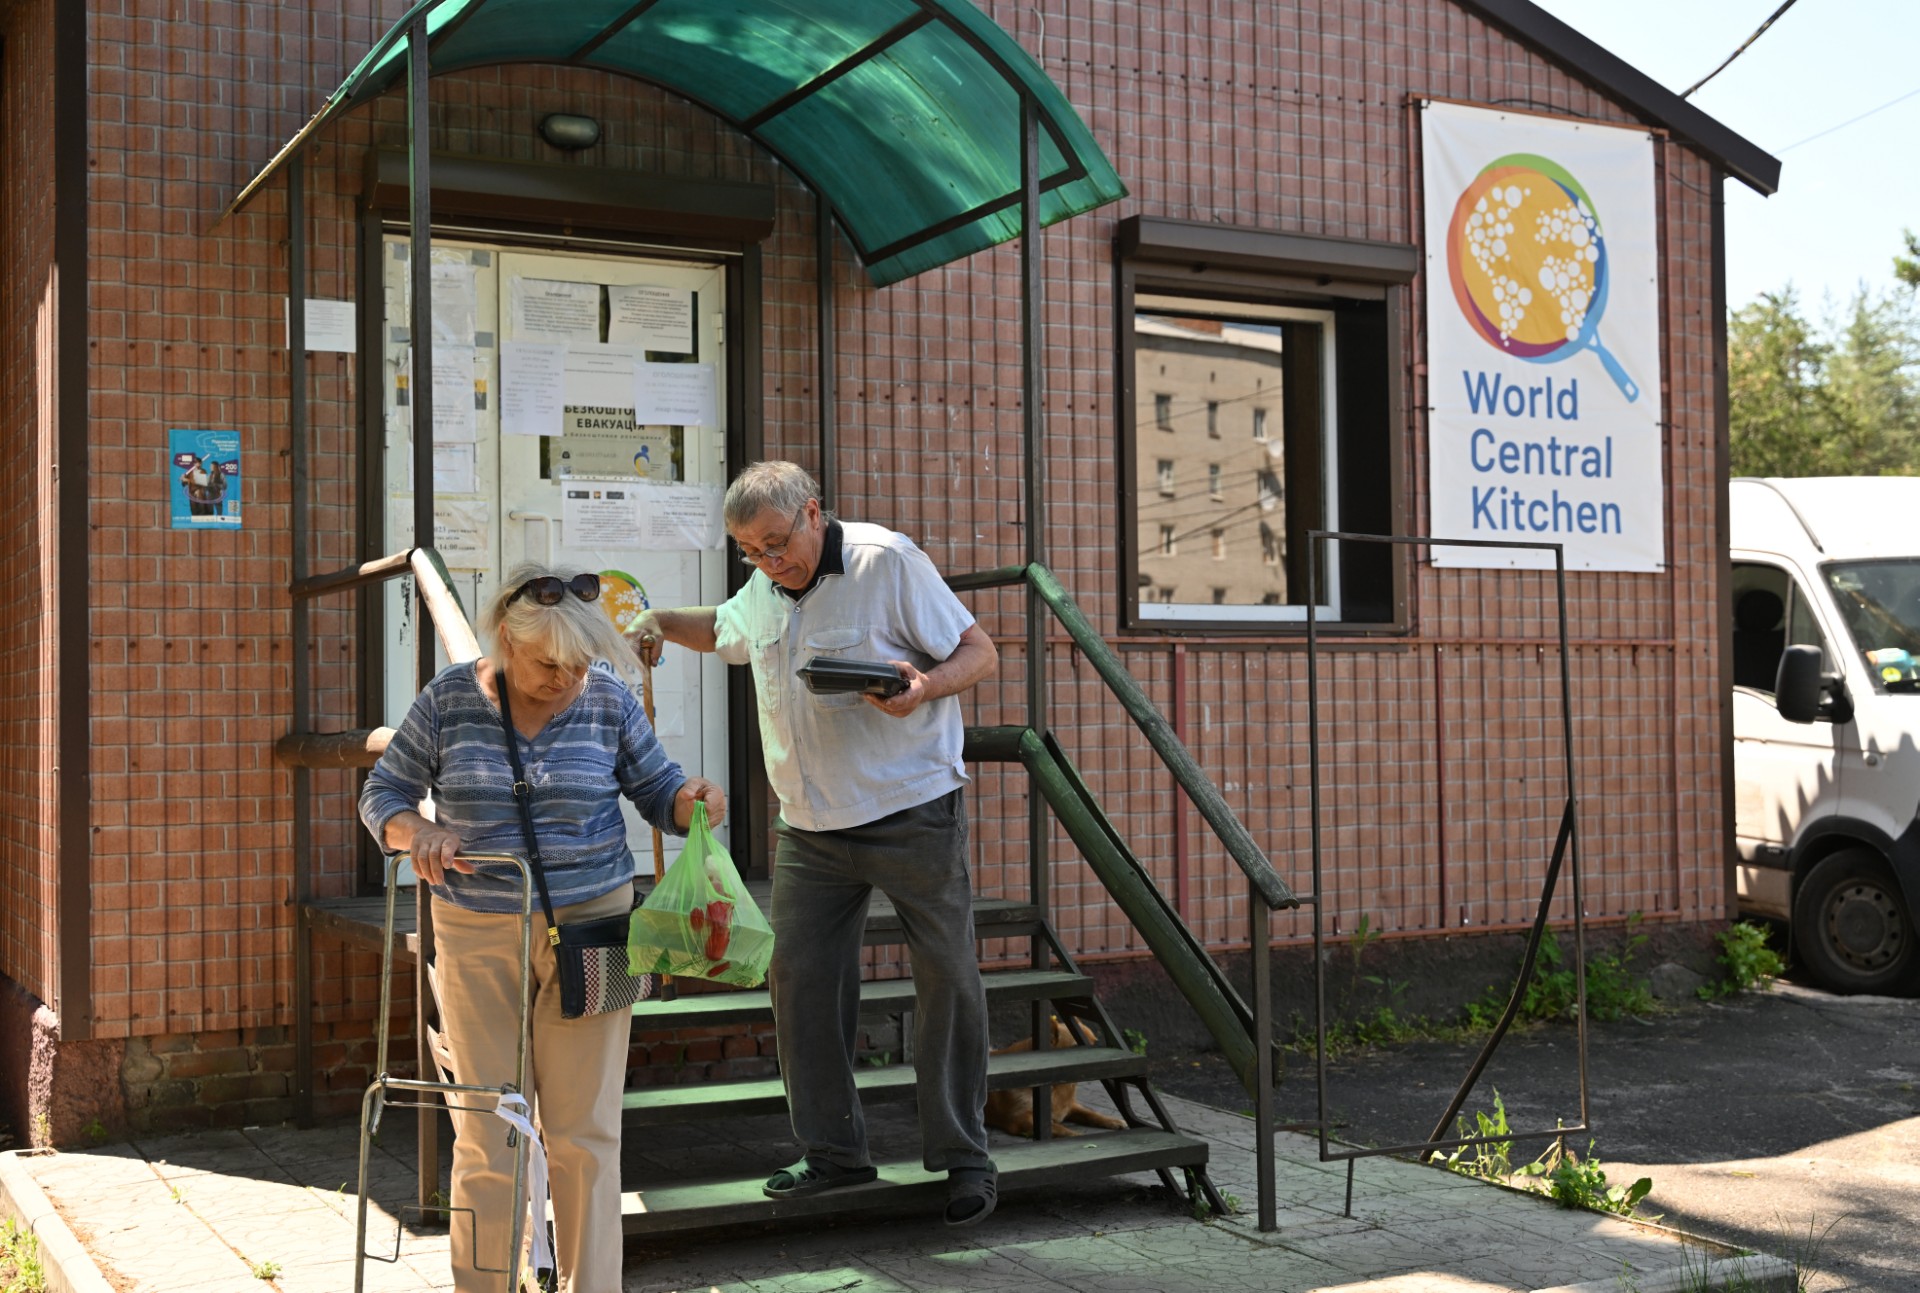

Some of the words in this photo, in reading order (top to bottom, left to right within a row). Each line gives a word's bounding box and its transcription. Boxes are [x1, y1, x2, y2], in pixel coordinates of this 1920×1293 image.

[1463, 370, 1578, 420] World
[1471, 428, 1612, 478] Central
[1472, 486, 1622, 534] Kitchen
